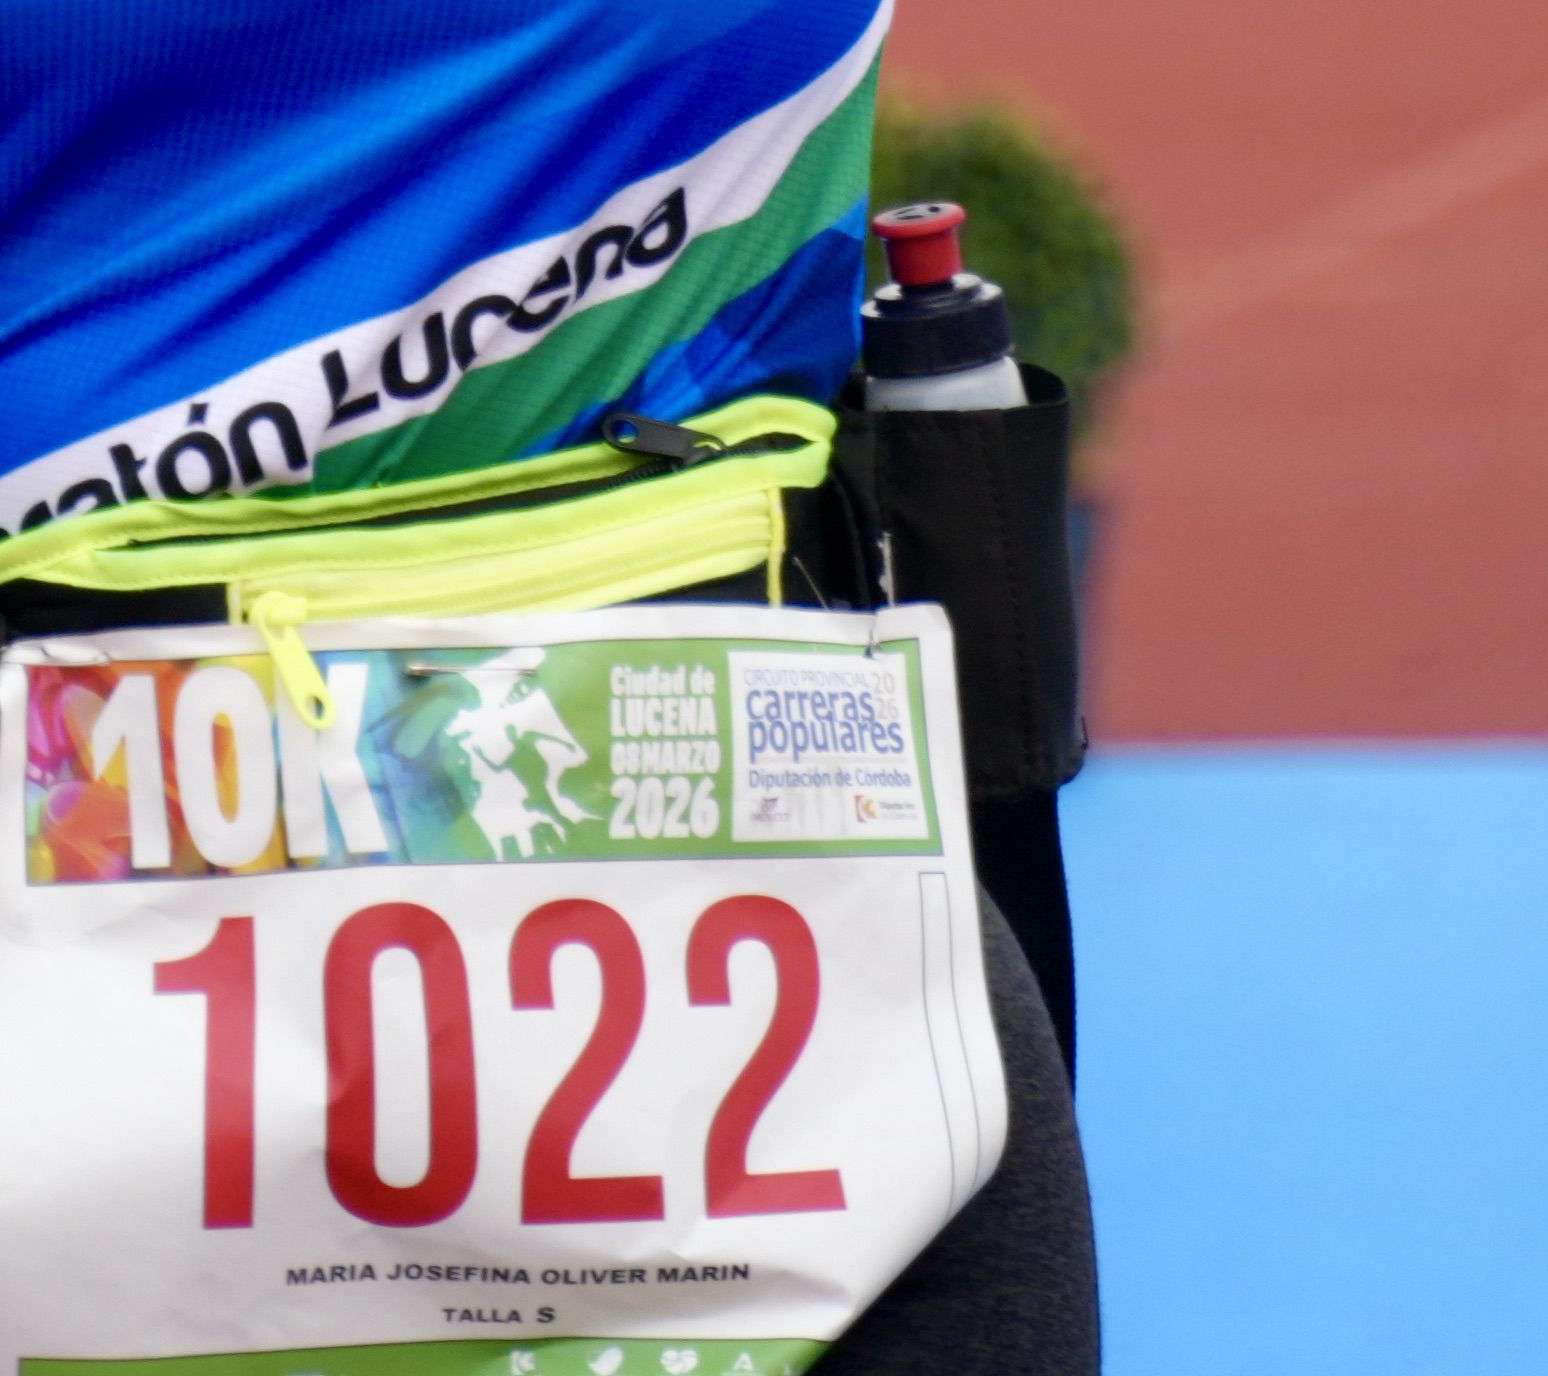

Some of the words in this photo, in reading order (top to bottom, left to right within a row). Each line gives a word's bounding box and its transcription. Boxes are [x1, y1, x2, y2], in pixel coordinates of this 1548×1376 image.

[321, 186, 688, 430] Lucena
[611, 664, 685, 696] Ciudad
[690, 664, 715, 695] de
[611, 697, 718, 737] LUCENA
[746, 689, 876, 722] carreras
[748, 720, 905, 764] populares
[91, 662, 389, 870] 10K
[749, 766, 833, 790] Diputación
[835, 767, 853, 787] de
[856, 768, 912, 788] Córdoba
[608, 776, 720, 839] 2026
[153, 893, 847, 1230] 1022
[286, 1263, 377, 1287] MARIA
[386, 1263, 531, 1285] JOSEFINA
[541, 1266, 646, 1285] OLIVER
[656, 1263, 750, 1283] MARIN
[443, 1307, 523, 1324] TALLA
[535, 1306, 556, 1324] S
